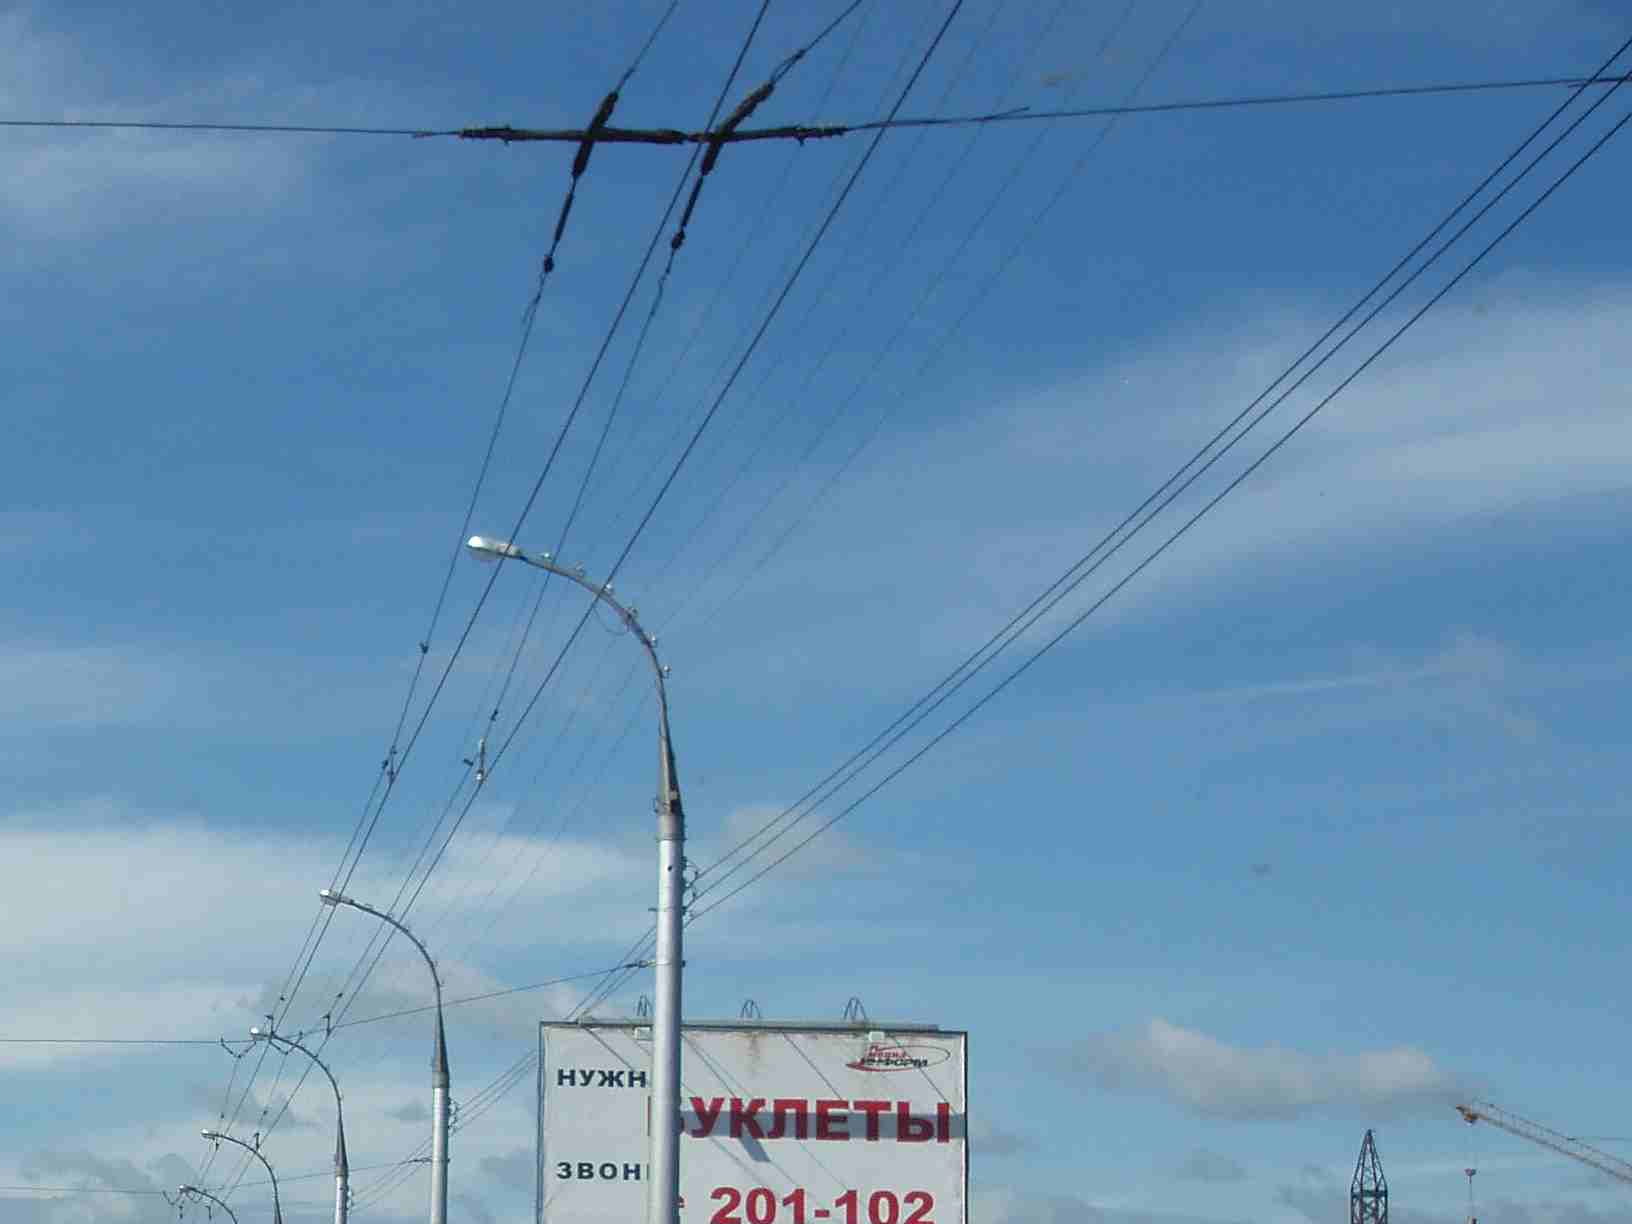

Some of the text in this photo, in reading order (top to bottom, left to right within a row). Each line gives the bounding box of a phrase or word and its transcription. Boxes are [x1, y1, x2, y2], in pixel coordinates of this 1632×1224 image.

[557, 1069, 648, 1088] НУЖН
[648, 1096, 951, 1143] УКЛЕТЫ
[556, 1161, 649, 1181] ЗВОН
